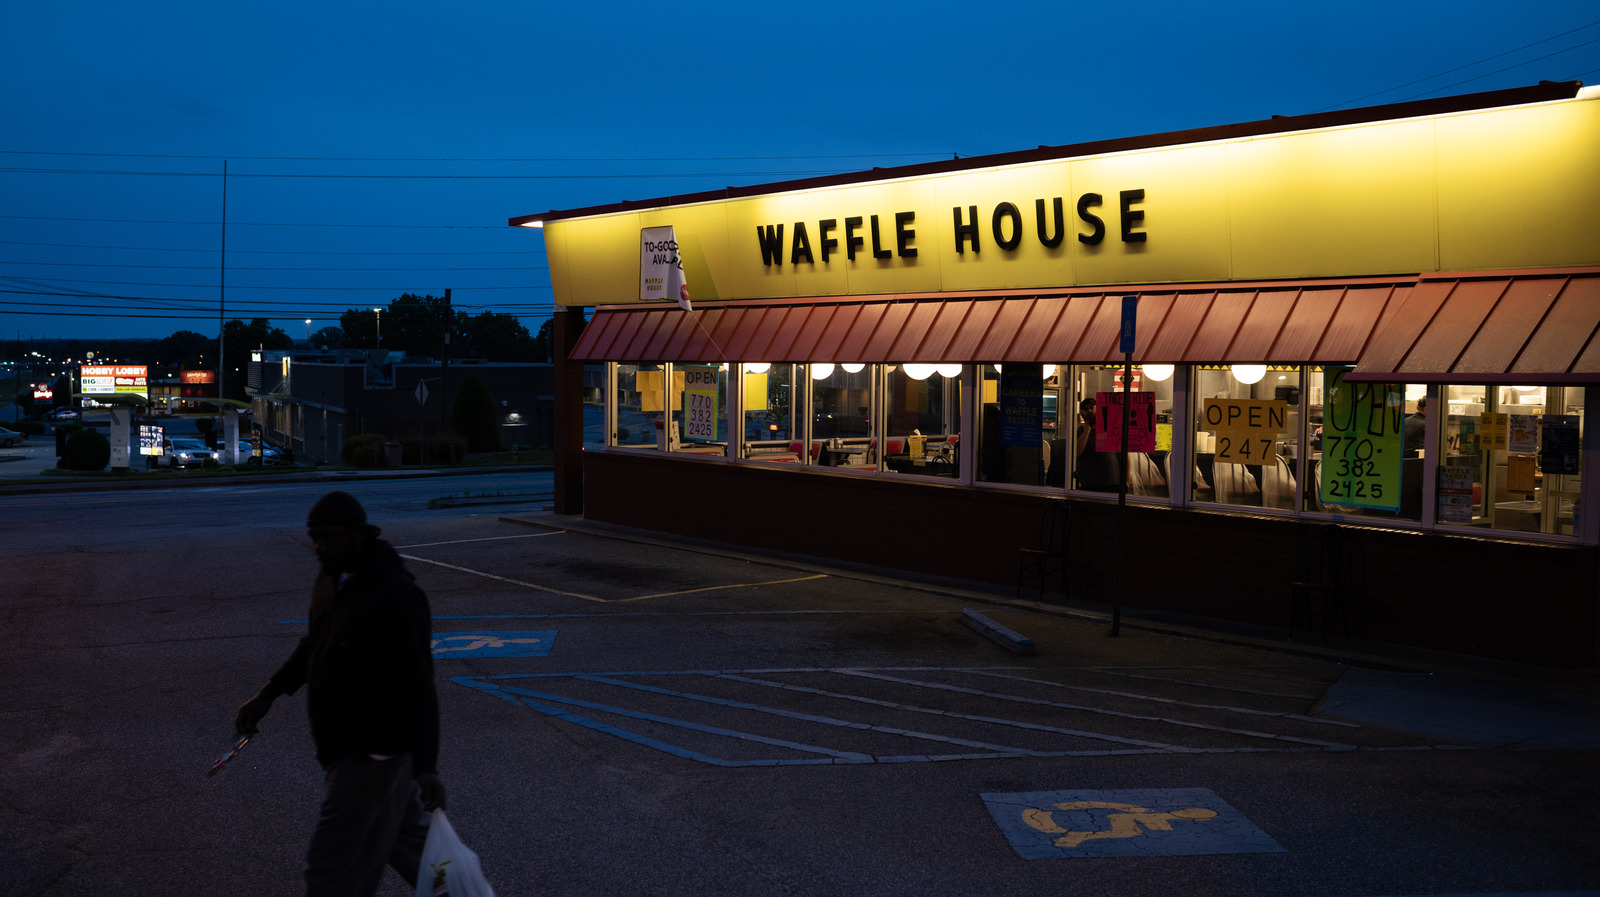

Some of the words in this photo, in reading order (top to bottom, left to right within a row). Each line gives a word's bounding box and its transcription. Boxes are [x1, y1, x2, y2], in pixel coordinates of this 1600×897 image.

[757, 211, 918, 266] WAFFLE
[953, 189, 1147, 254] HOUSE
[82, 367, 115, 375] HOBBY
[115, 367, 146, 375] LOBBY
[687, 371, 717, 384] OPEN
[1002, 387, 1042, 398] CAREERS
[691, 394, 711, 409] 770
[1017, 398, 1026, 406] TO
[1330, 369, 1402, 436] OPEN
[691, 408, 711, 423] 382
[1004, 406, 1038, 417] WAFFLE
[1206, 404, 1284, 428] OPEN
[688, 422, 712, 437] 2425
[1219, 437, 1272, 460] 247
[1336, 459, 1381, 477] 382
[1329, 480, 1383, 498] 2425
